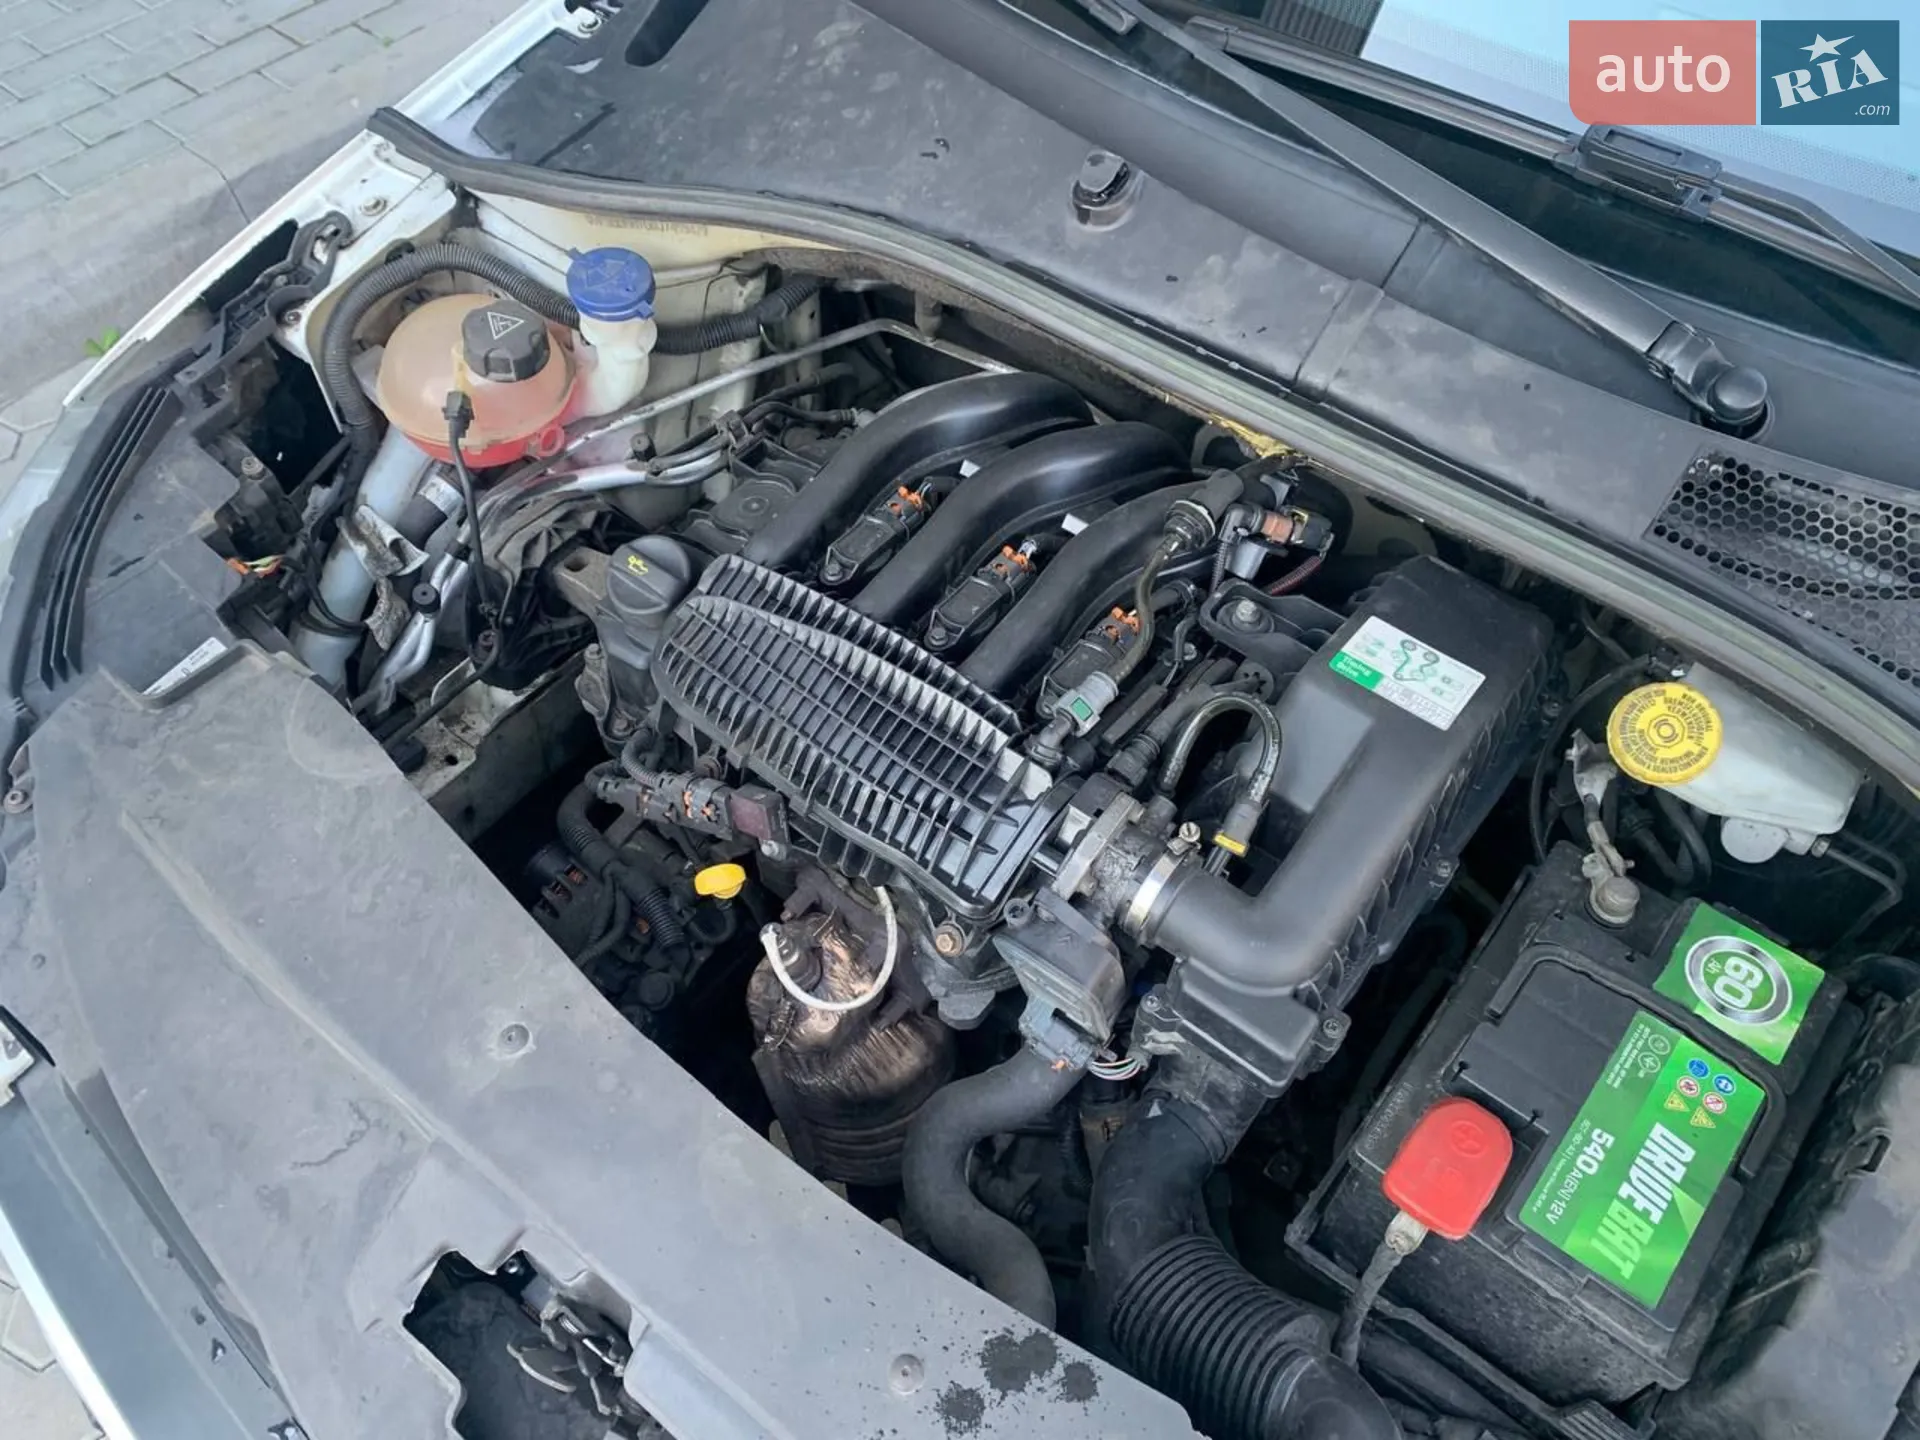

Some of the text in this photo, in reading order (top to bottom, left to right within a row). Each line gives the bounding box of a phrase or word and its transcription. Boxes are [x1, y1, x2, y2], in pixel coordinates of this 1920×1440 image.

[1714, 956, 1764, 1008] 60
[1618, 1122, 1696, 1224] DRIVE
[1545, 1199, 1567, 1225] 12V
